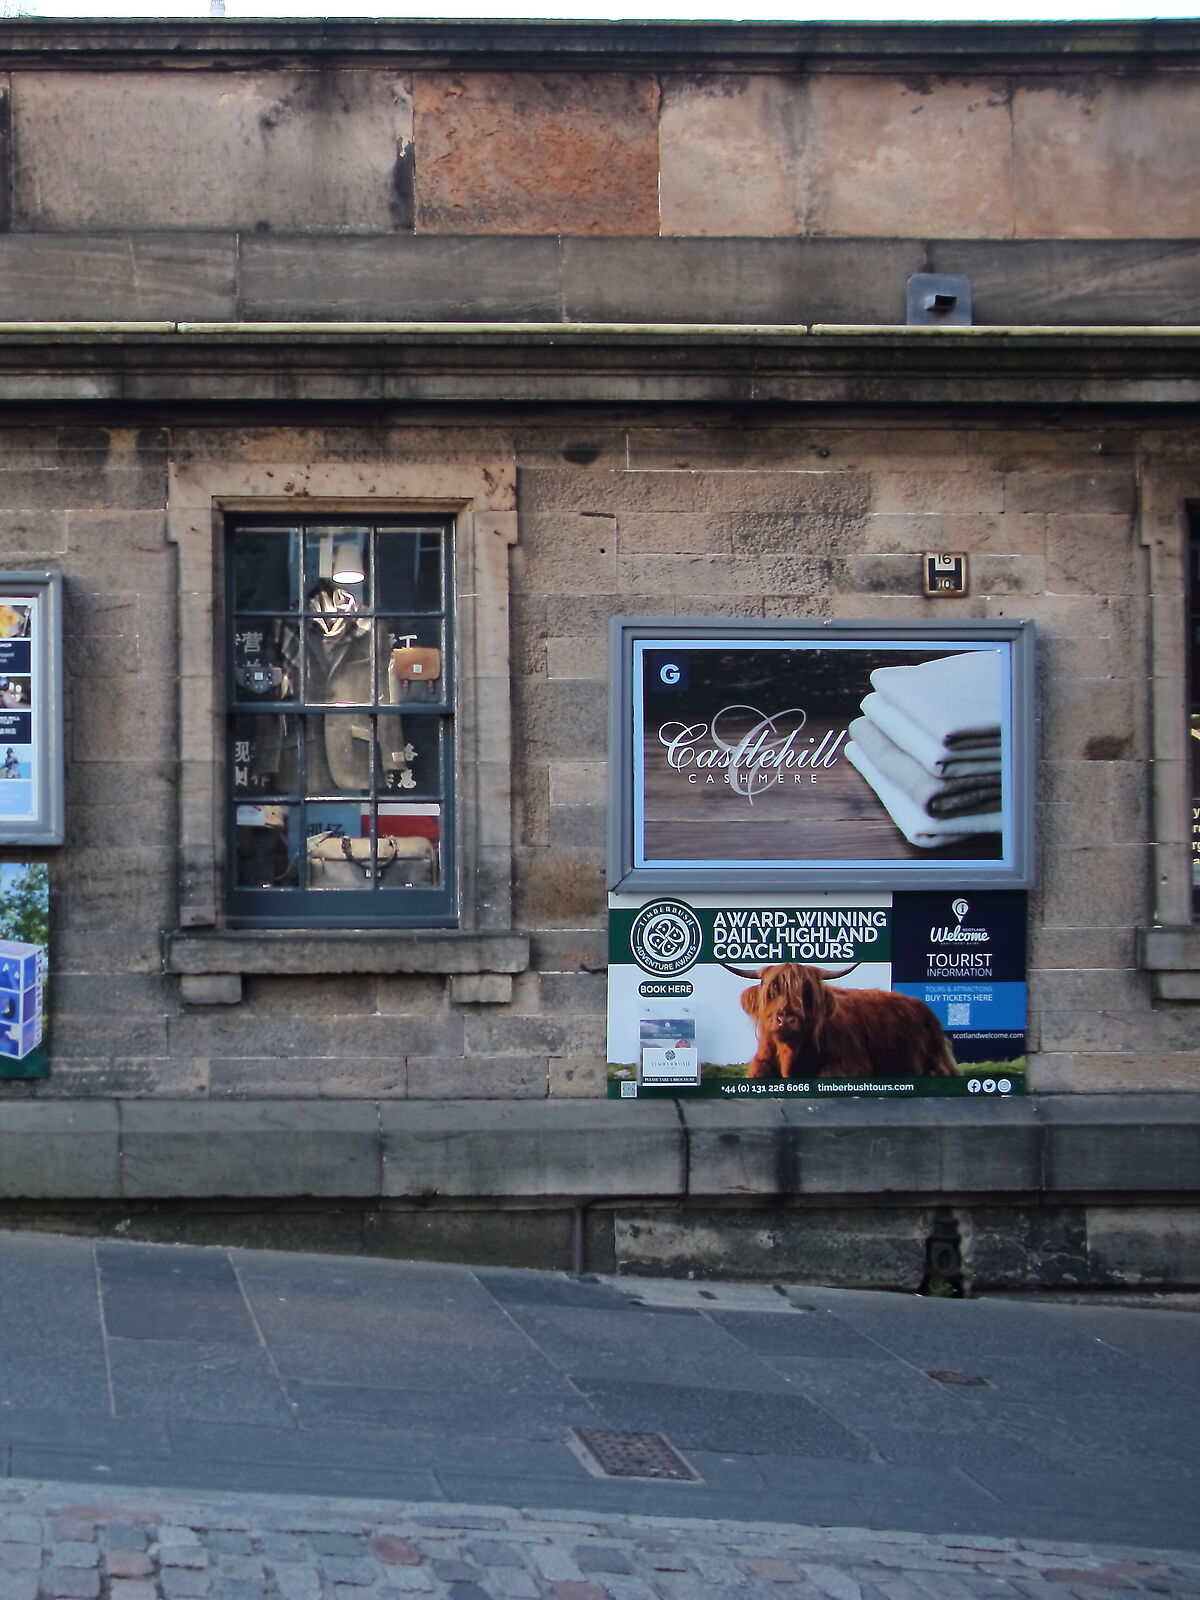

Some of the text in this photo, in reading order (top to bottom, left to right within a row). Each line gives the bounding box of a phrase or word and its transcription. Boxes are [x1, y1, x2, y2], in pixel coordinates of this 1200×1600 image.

[660, 663, 681, 685] G
[658, 721, 847, 773] Castlehill
[688, 773, 818, 784] CASHMERE
[639, 906, 695, 927] TIMBERBUSH
[713, 911, 887, 928] AWARD-WINNING
[713, 927, 878, 943] DAILY HIGHLAND
[930, 925, 990, 942] Welcome
[636, 945, 697, 971] ADVENTURE AWAITS
[713, 943, 855, 959] COACH TOURS
[926, 953, 993, 967] TOURIST
[926, 968, 993, 977] INFORMATION
[640, 985, 692, 993] BOOK HERE
[721, 1083, 810, 1093] +44 (0) 131 226 6066
[817, 1083, 914, 1092] timberbushtours.com
